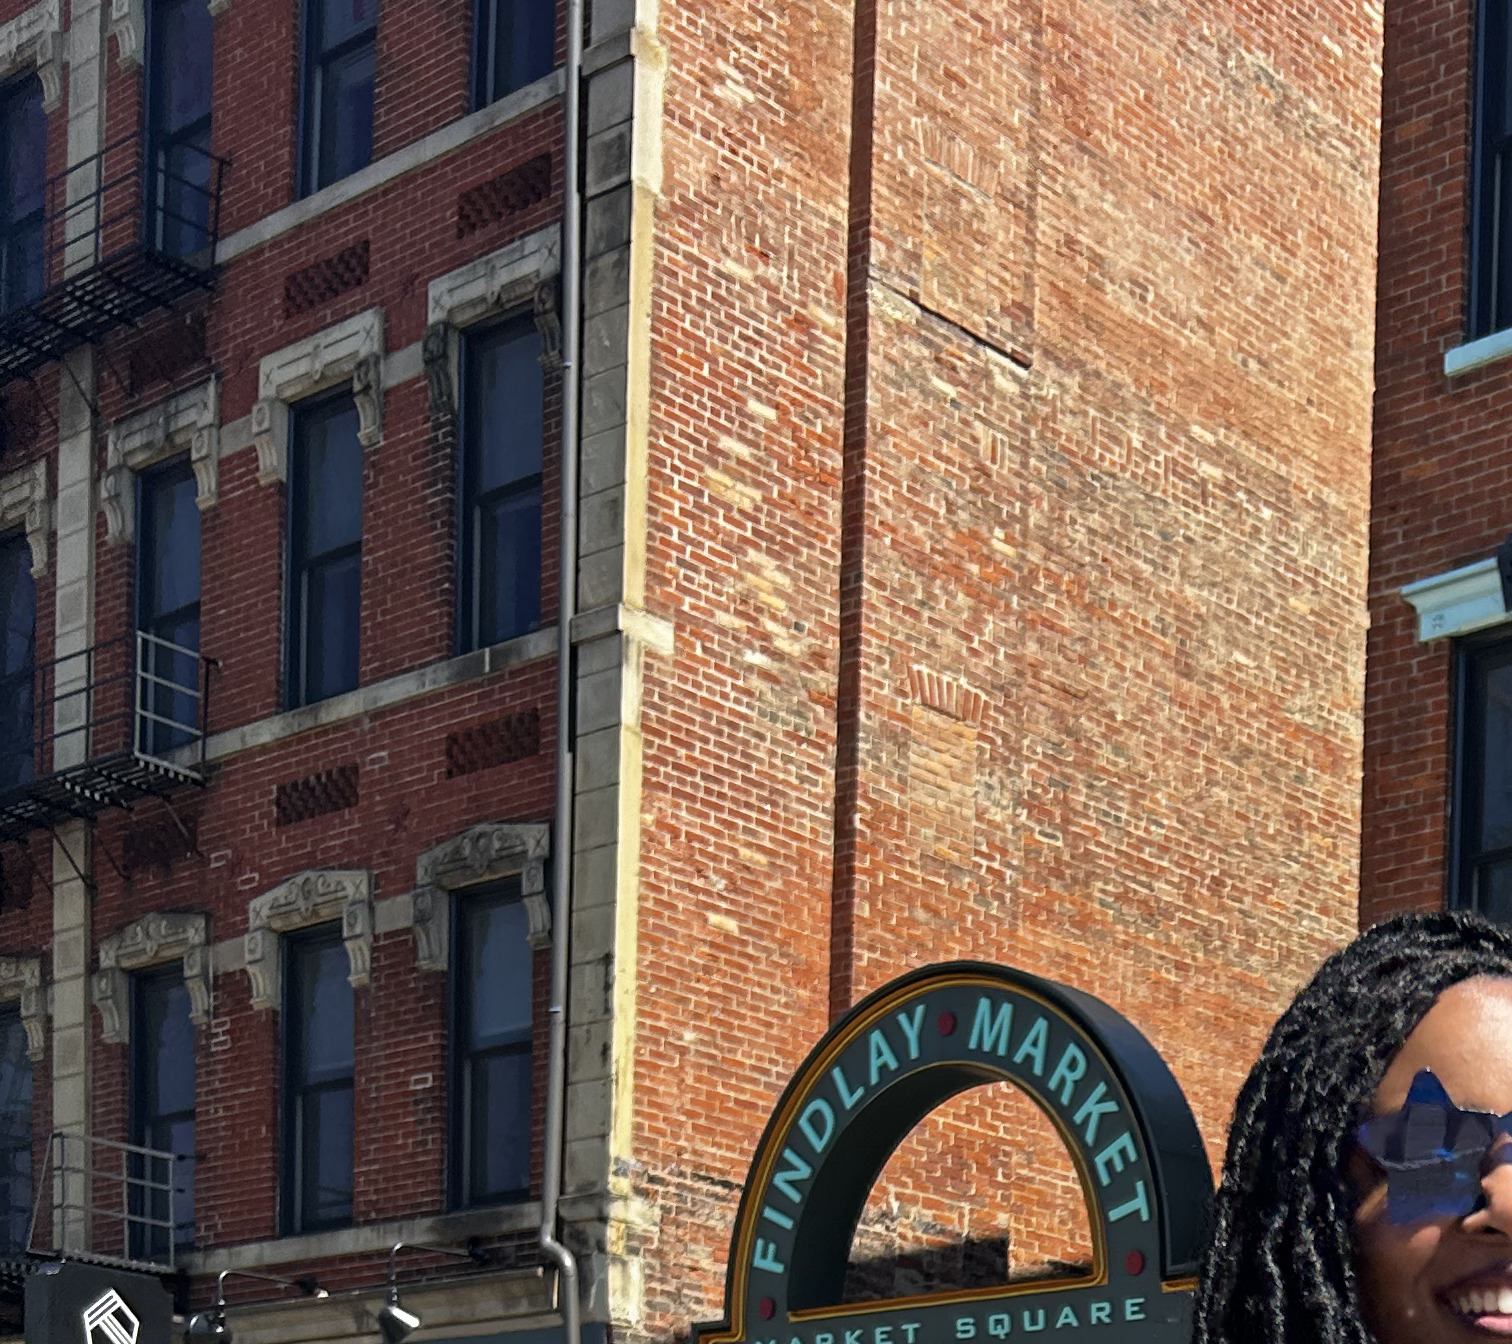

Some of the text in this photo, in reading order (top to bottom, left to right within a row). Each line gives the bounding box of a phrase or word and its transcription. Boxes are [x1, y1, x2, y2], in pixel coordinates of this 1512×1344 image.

[753, 997, 1149, 1274] FINDLAY MARKET
[955, 1297, 1147, 1340] SQUARE
